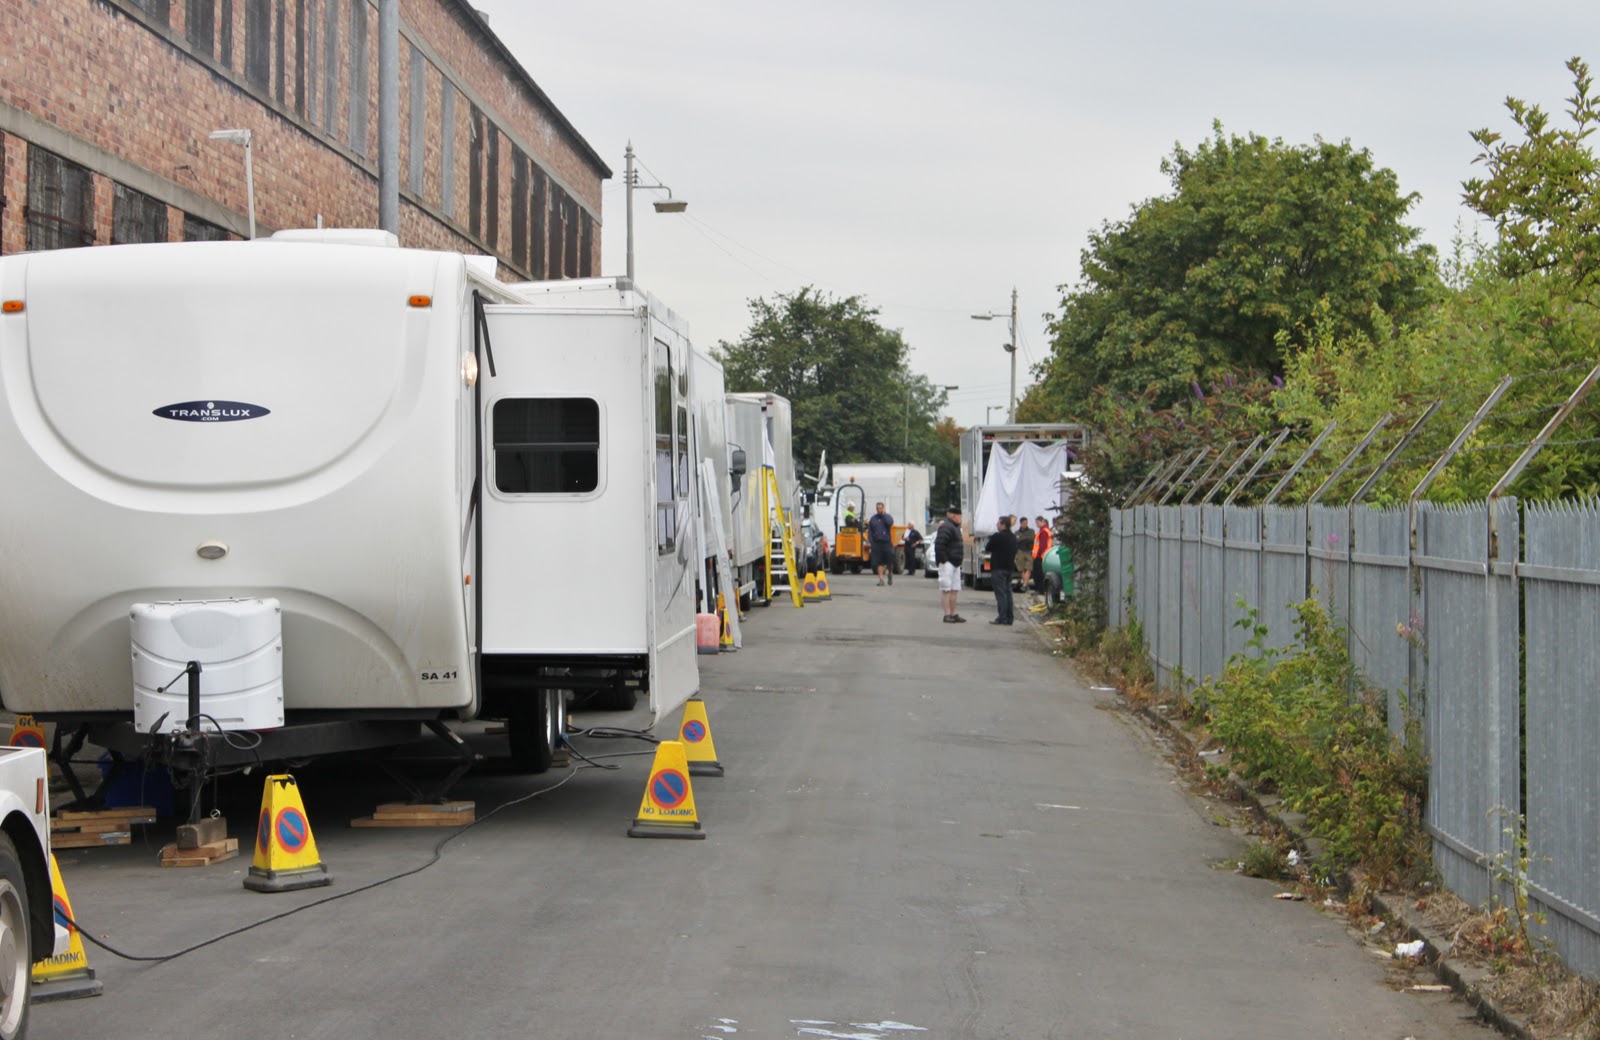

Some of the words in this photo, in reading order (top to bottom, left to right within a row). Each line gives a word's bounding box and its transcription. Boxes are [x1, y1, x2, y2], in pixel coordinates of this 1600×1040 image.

[421, 672, 438, 680] SA
[443, 671, 456, 679] 41
[659, 808, 694, 816] LOADING
